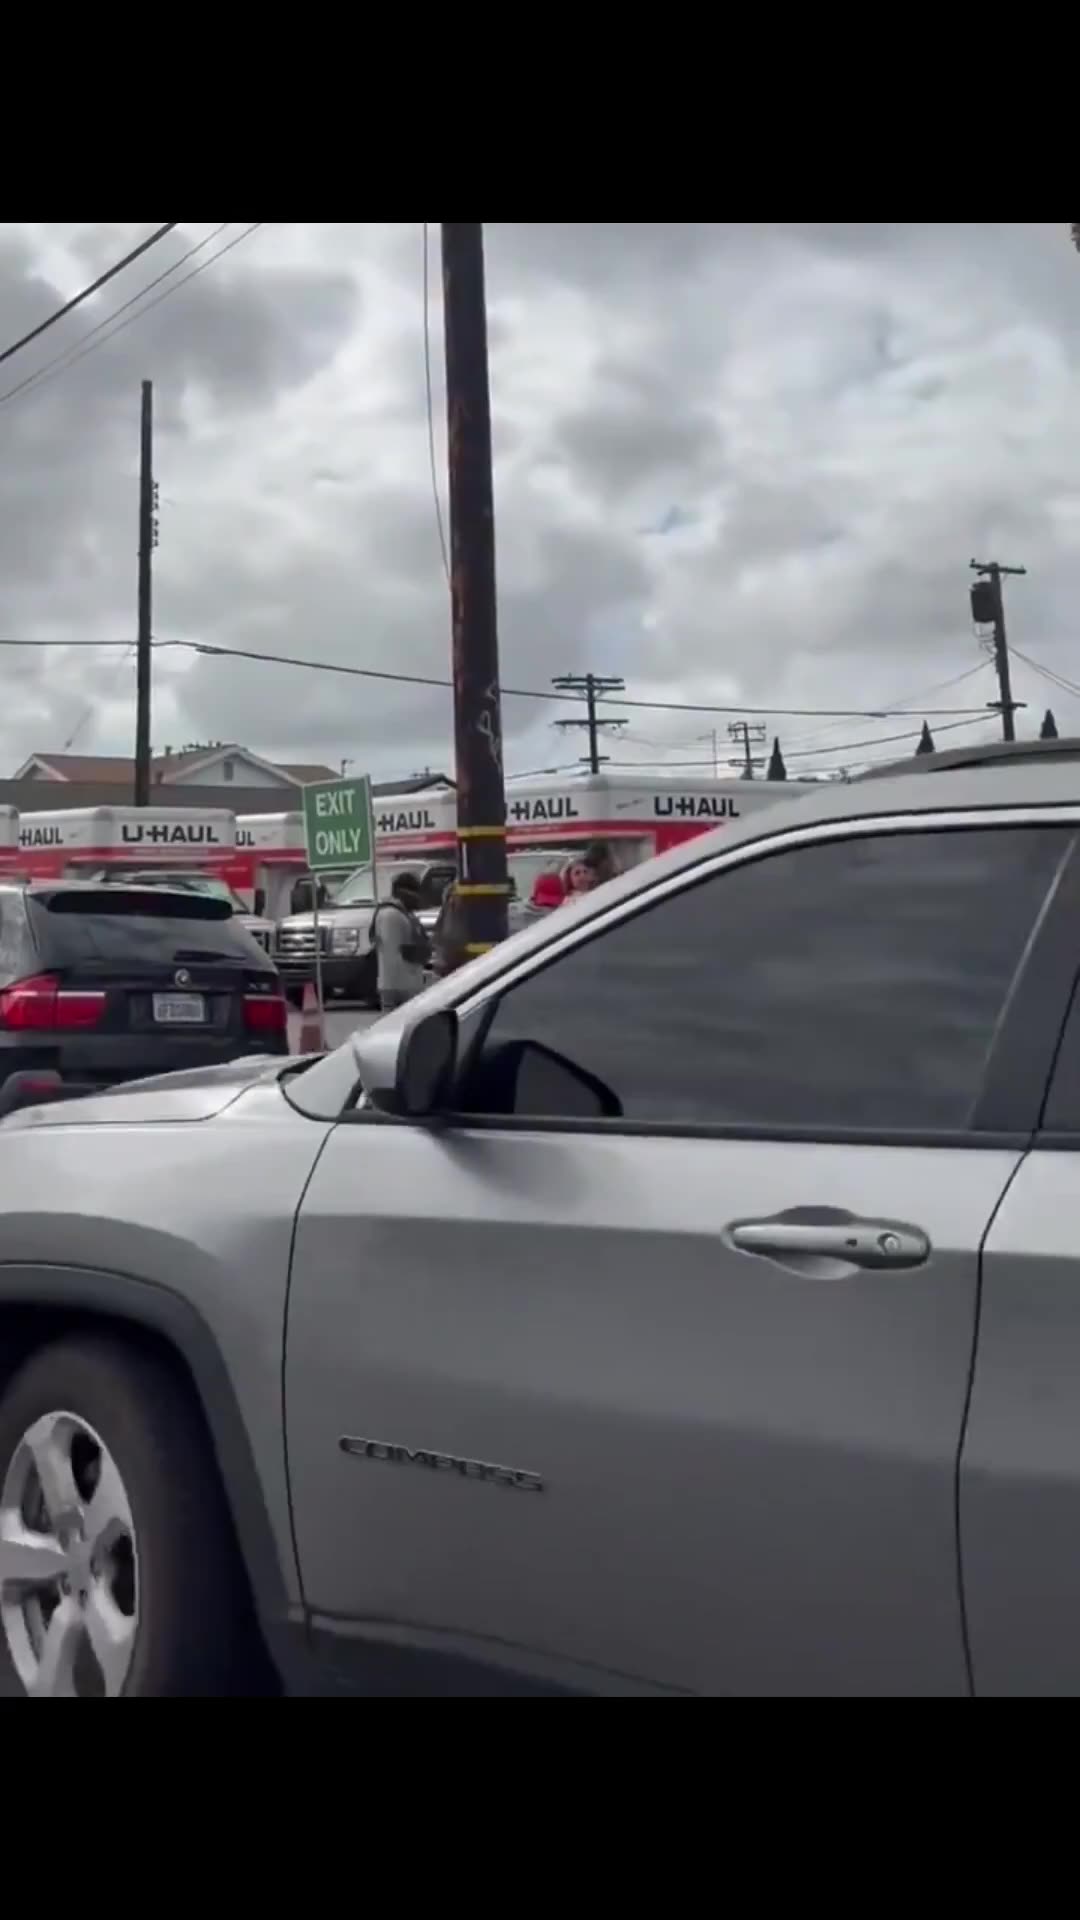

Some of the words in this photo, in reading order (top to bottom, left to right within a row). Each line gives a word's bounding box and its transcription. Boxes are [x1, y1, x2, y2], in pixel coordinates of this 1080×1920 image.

[316, 789, 355, 816] EXIT
[505, 797, 578, 820] -HAUL
[654, 796, 740, 817] U-HAUL
[378, 810, 435, 832] -HAUL
[19, 827, 63, 846] -HAUL
[122, 824, 219, 843] U-HAUL
[316, 829, 361, 856] ONLY
[339, 1435, 544, 1491] COMPASS
